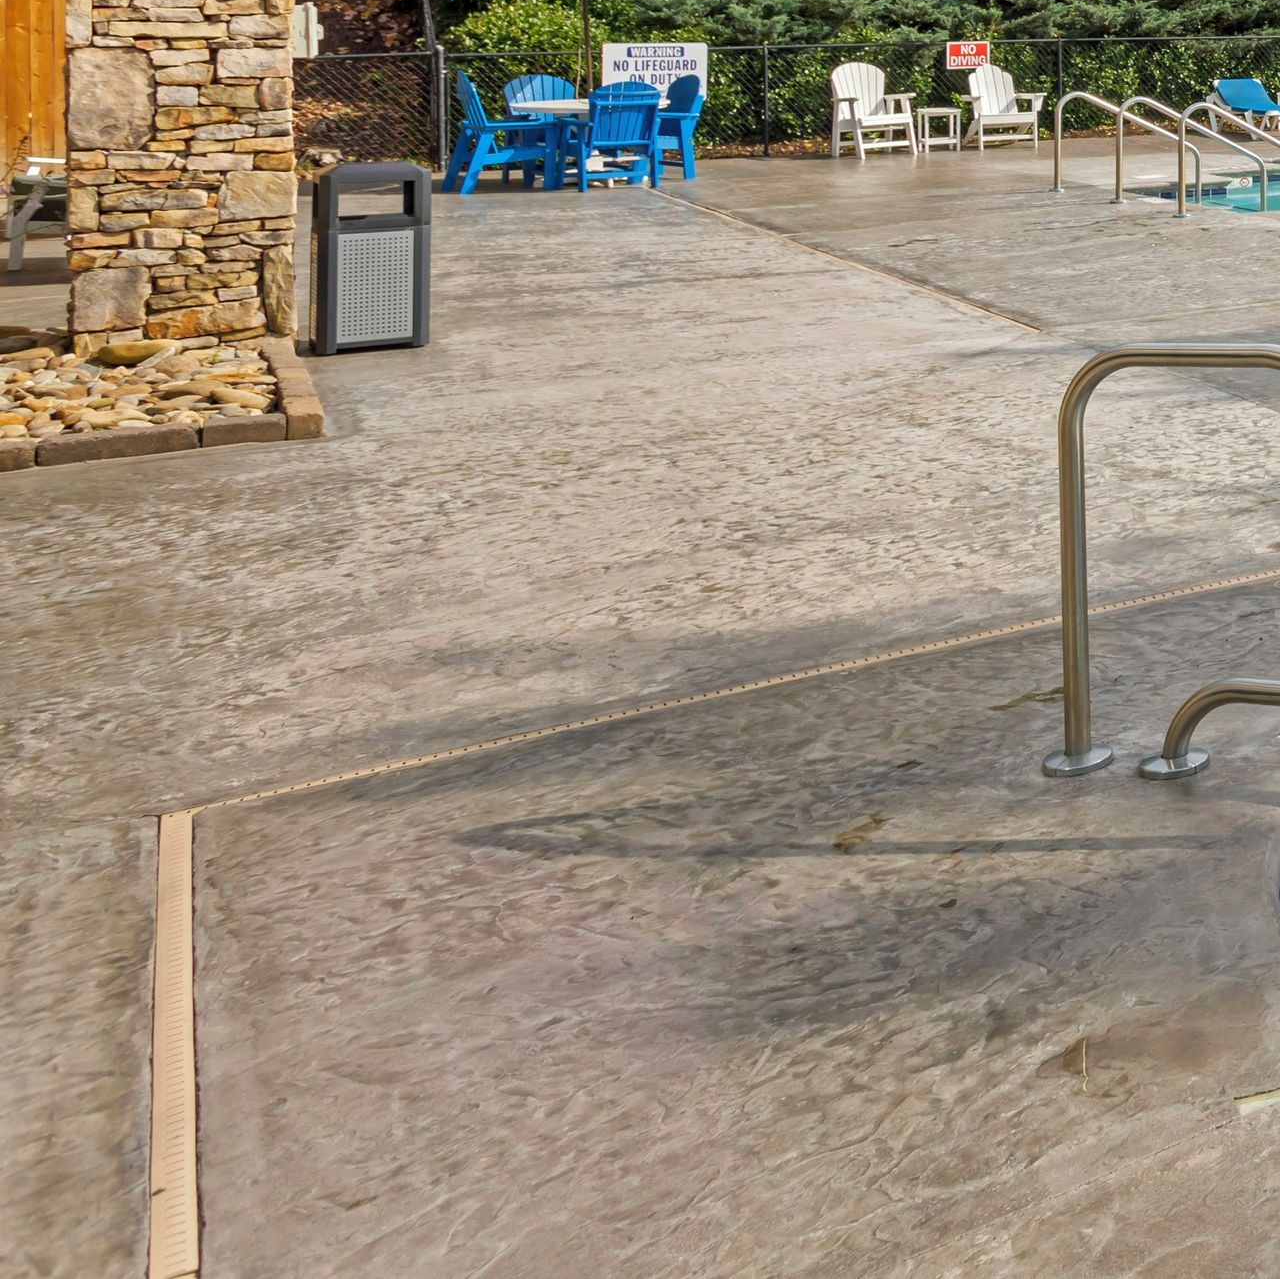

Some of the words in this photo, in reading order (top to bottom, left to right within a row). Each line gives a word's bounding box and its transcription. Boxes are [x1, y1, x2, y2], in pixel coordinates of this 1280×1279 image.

[630, 46, 682, 57] WARNING
[960, 44, 977, 55] NO
[613, 60, 629, 71] NO
[634, 59, 697, 71] LIFEGUARD
[950, 55, 986, 66] DIVING
[629, 73, 645, 83] ON
